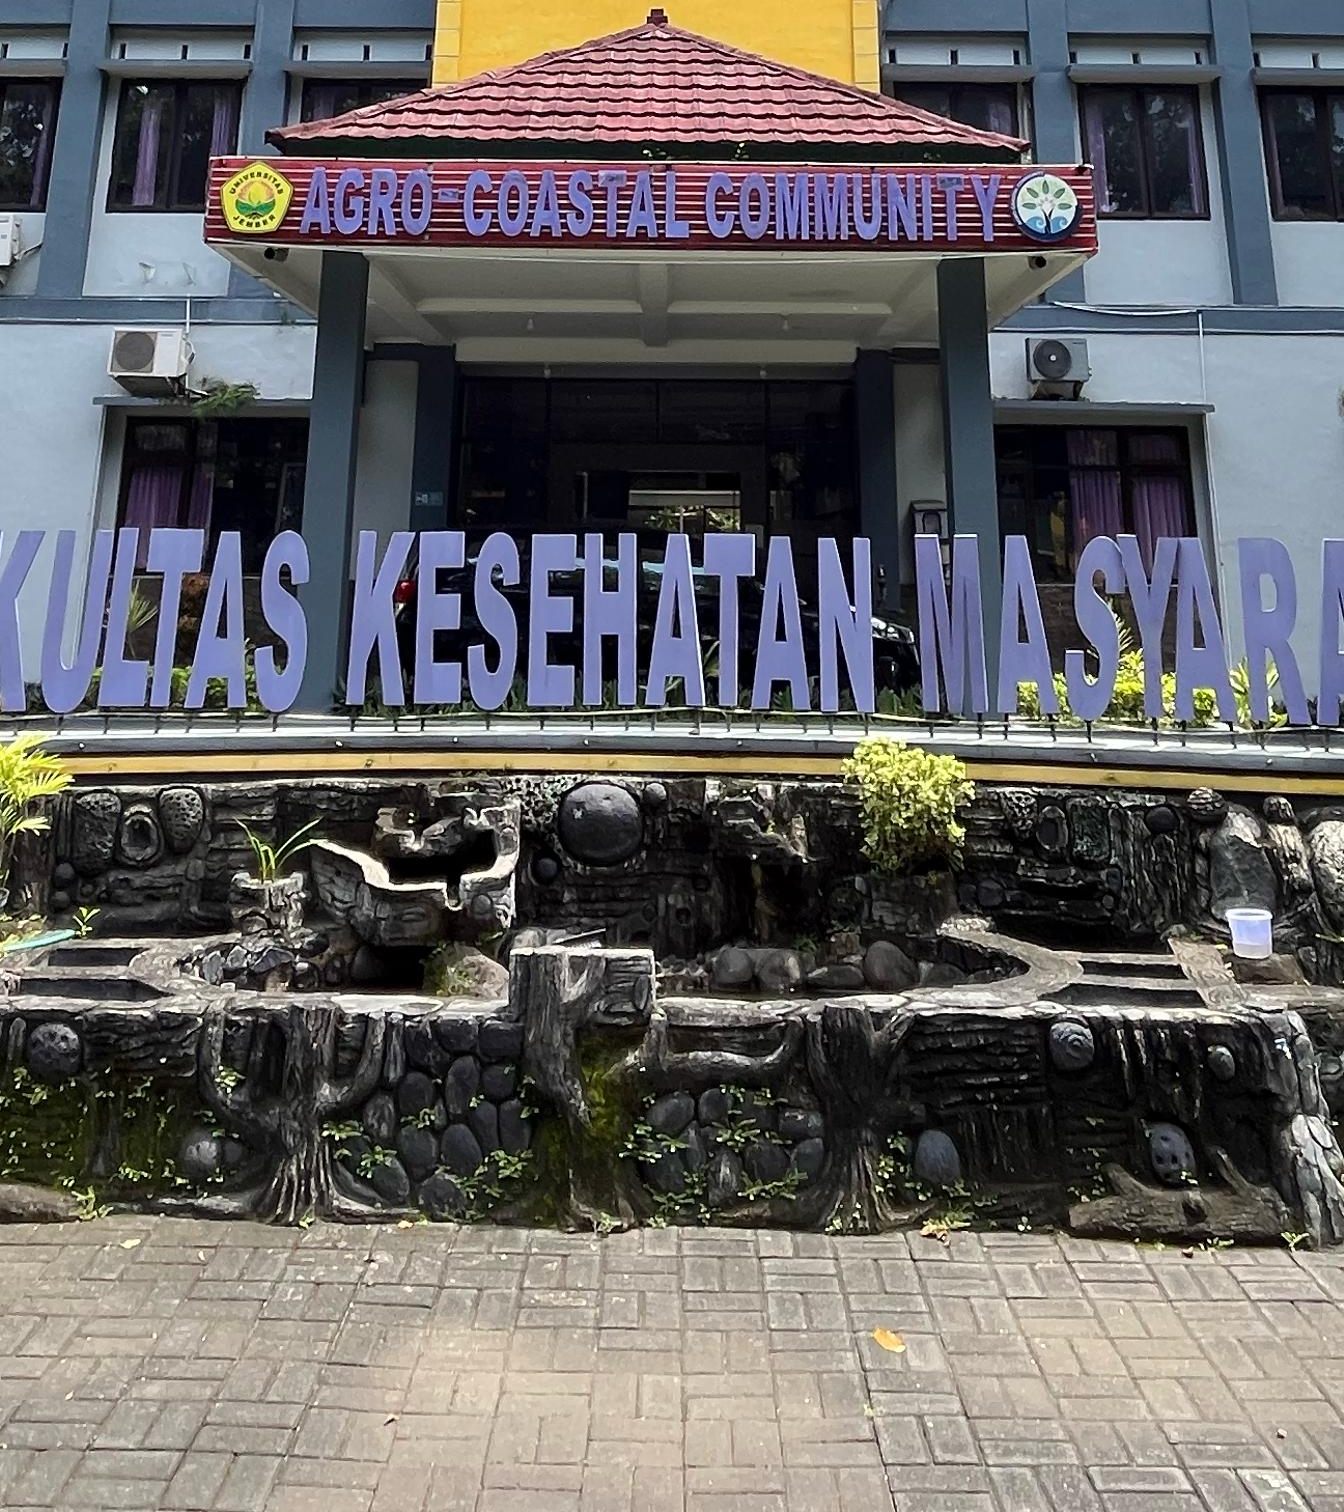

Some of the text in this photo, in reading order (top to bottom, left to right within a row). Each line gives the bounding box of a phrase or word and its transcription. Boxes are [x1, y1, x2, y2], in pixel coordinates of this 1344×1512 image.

[229, 171, 284, 195] UNIVERSITAS
[705, 171, 1001, 242] COMMUNITY
[233, 214, 276, 228] JEMBER
[346, 530, 875, 713] KESEHATAN
